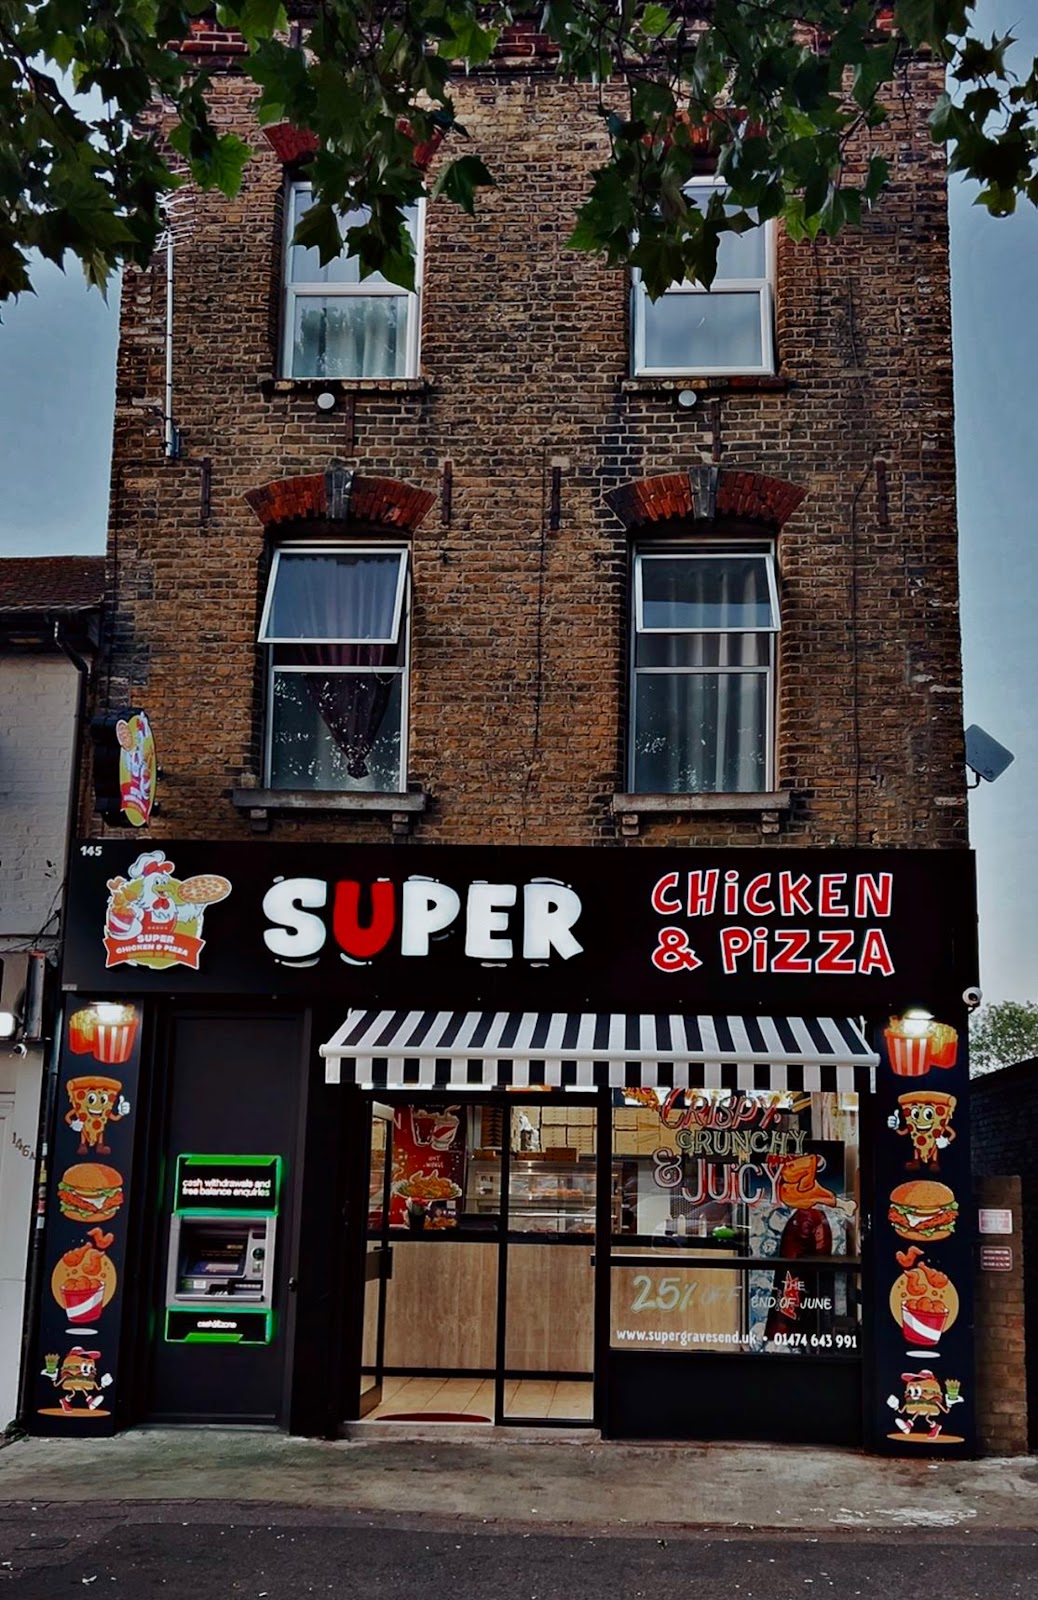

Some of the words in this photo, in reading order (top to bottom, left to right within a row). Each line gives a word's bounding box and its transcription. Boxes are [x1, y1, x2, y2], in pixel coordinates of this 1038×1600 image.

[80, 845, 103, 857] 145
[262, 876, 584, 960] SUPER
[136, 934, 175, 944] SUPER
[115, 943, 155, 954] CHICKEN
[163, 944, 189, 957] PIZZA
[651, 926, 702, 972] &
[652, 1147, 682, 1189] &
[182, 1178, 203, 1187] cash
[204, 1178, 253, 1188] withdrawals
[254, 1179, 271, 1189] and
[182, 1186, 199, 1195] free
[200, 1186, 232, 1196] balance
[233, 1186, 270, 1197] enquiries
[781, 1280, 806, 1292] THE
[630, 1275, 698, 1314] 25%
[751, 1296, 777, 1309] END
[779, 1297, 797, 1309] OF
[800, 1297, 832, 1310] JUNE
[616, 1330, 757, 1346] www.supergravesend.uk
[774, 1332, 808, 1347] 01474
[810, 1333, 833, 1348] 643
[835, 1335, 858, 1349] 991
